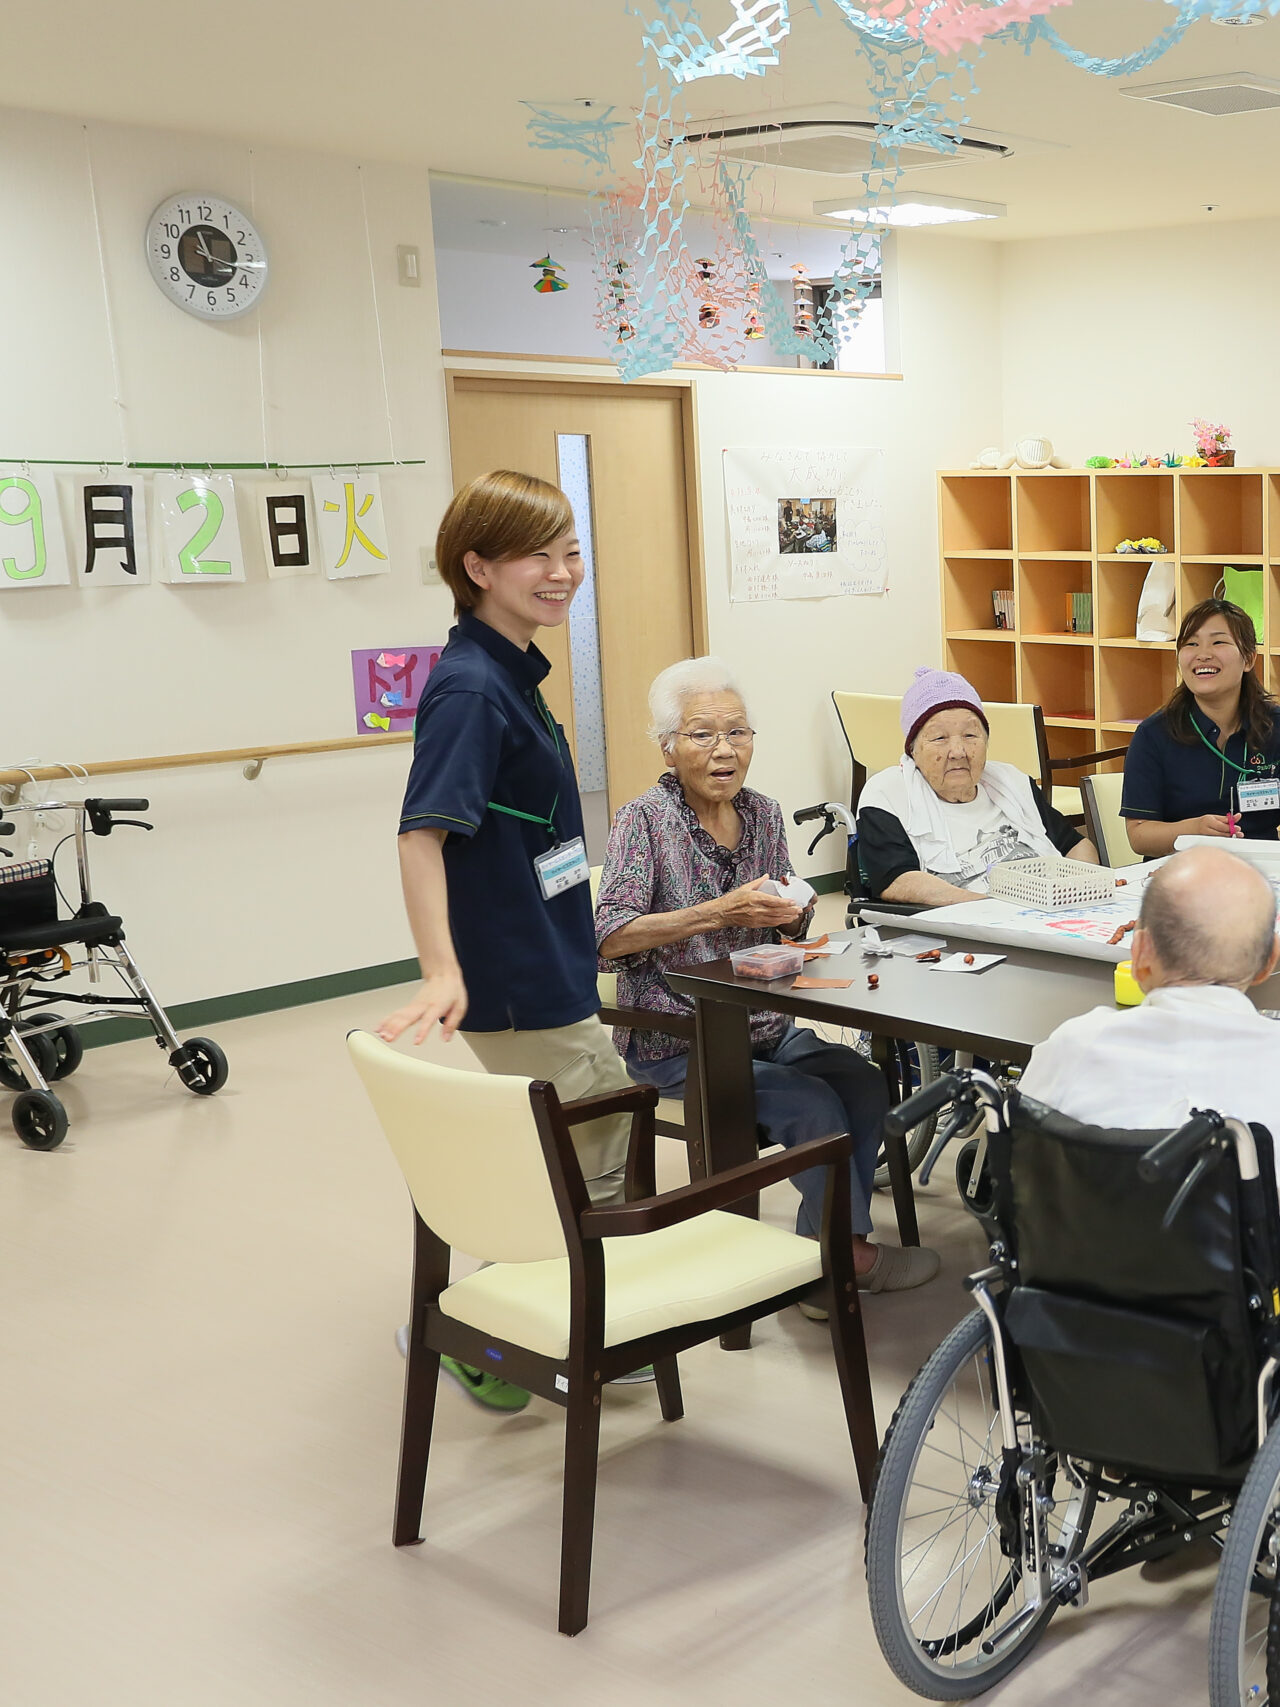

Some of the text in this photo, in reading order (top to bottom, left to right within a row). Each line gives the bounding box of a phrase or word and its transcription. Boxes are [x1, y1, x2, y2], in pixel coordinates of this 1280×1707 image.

[178, 209, 191, 224] 11
[197, 205, 213, 222] 12
[223, 214, 229, 229] 1
[163, 223, 180, 239] 10
[237, 231, 246, 246] 2
[161, 244, 171, 259] 9
[170, 267, 180, 281] 8
[239, 274, 249, 288] 4
[186, 284, 196, 299] 7
[207, 291, 217, 306] 6
[226, 288, 236, 302] 5
[367, 652, 439, 703] トイ
